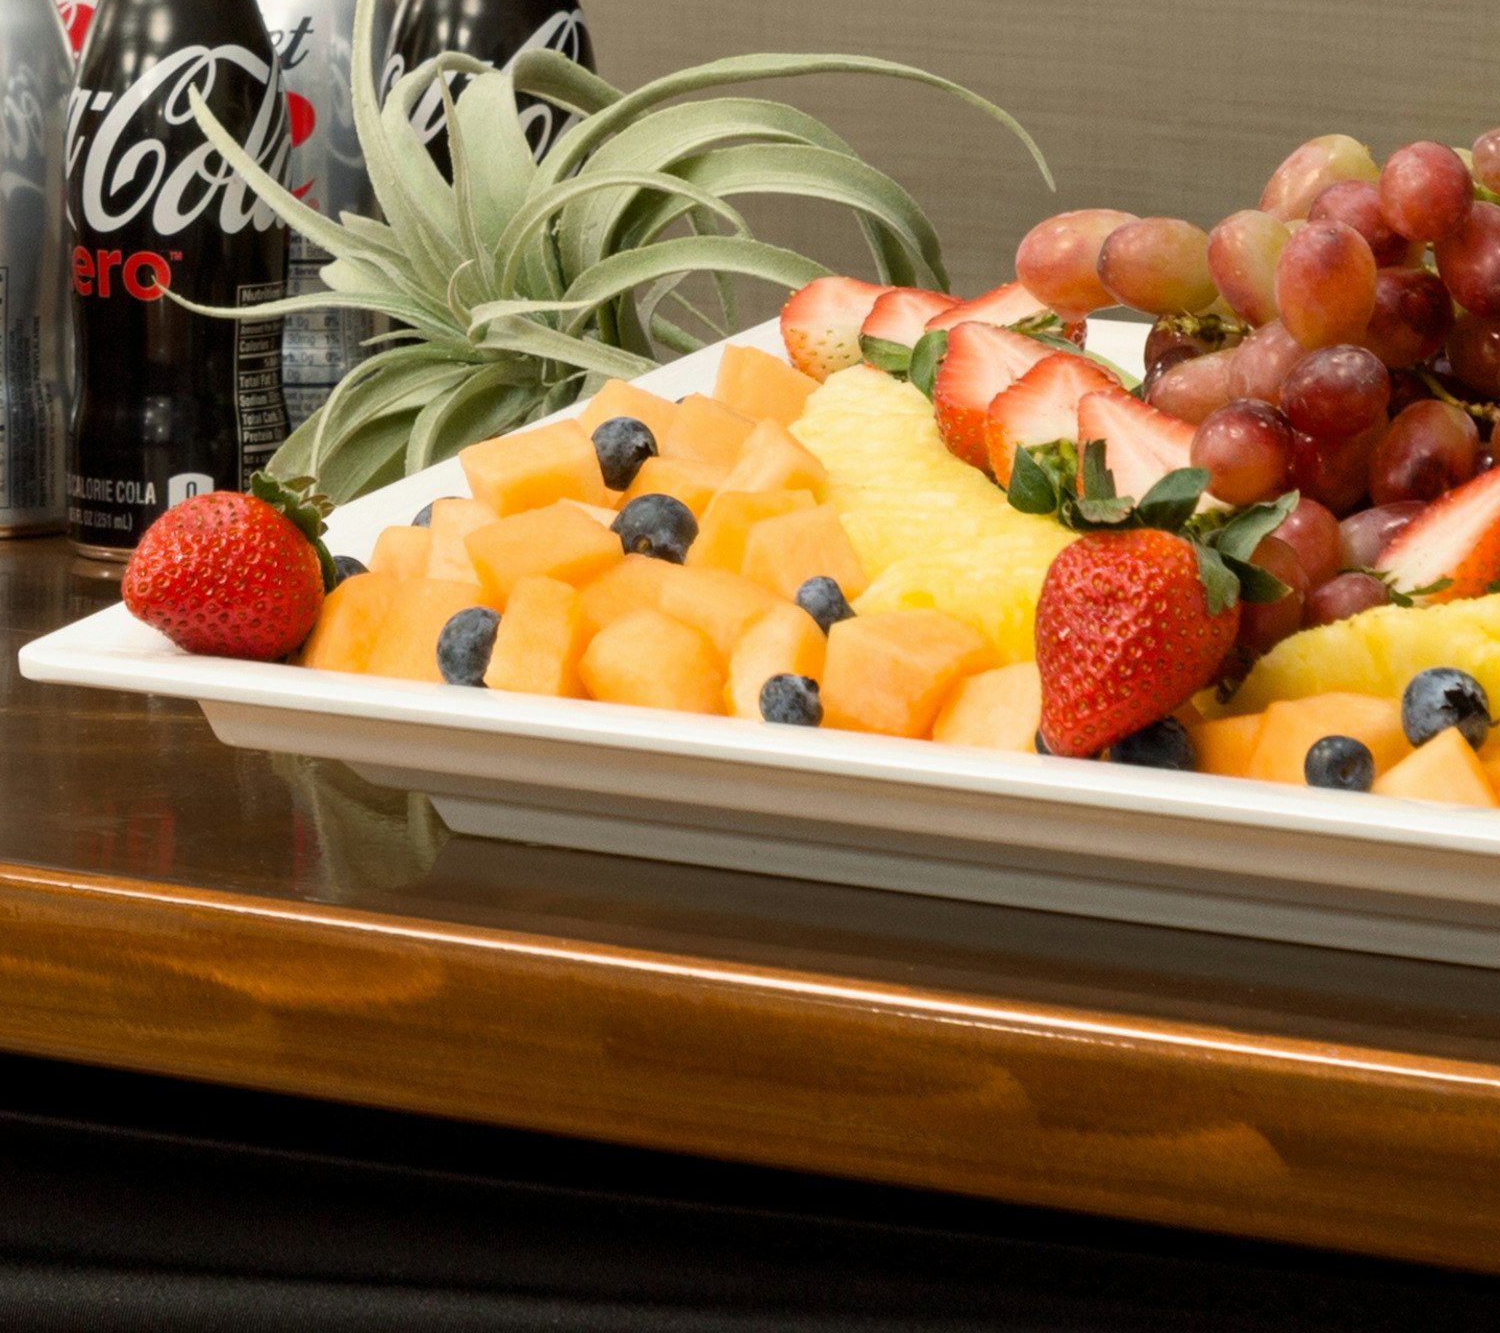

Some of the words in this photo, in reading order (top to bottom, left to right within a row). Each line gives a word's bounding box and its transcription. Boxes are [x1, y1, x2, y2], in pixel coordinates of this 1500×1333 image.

[72, 245, 172, 302] ero
[116, 480, 157, 505] COLA
[114, 512, 133, 532] mL)
